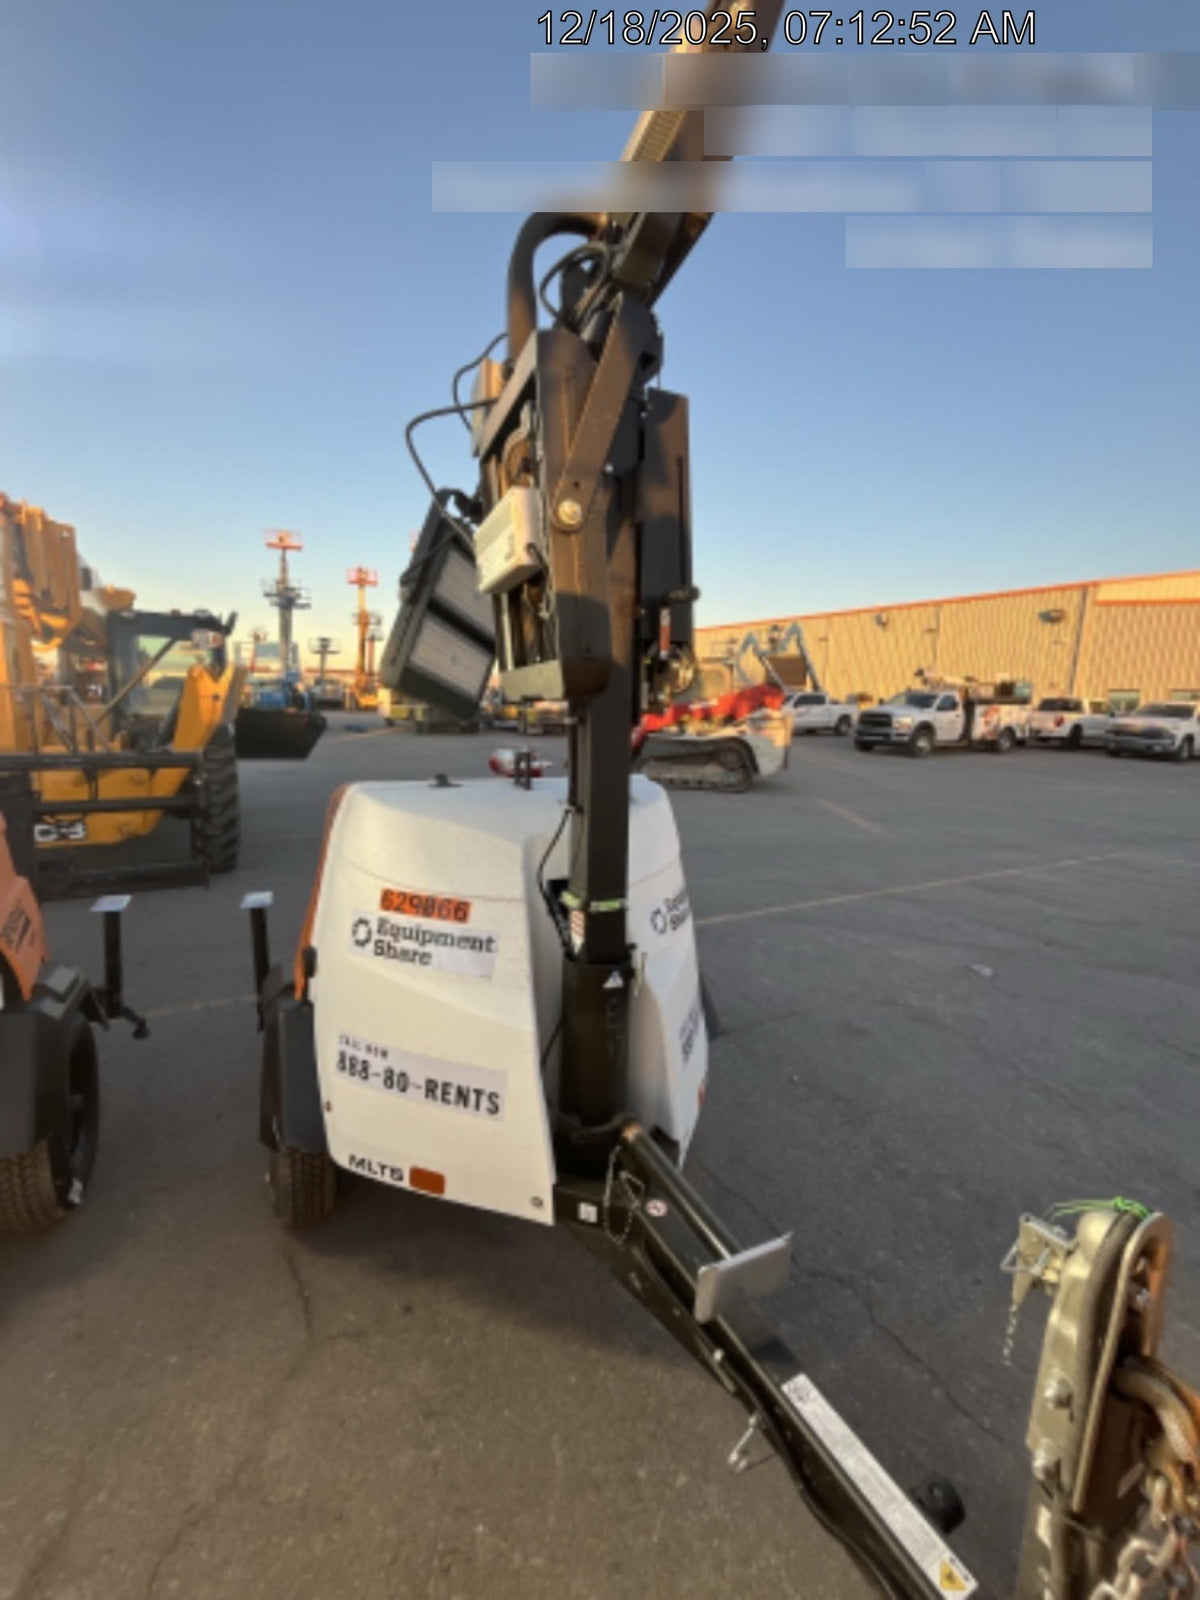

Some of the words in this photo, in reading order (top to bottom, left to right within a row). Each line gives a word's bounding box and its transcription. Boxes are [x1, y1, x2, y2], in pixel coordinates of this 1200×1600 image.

[377, 917, 495, 952] Equipment
[373, 939, 432, 966] Share
[337, 1050, 501, 1116] 888-80-RENTS
